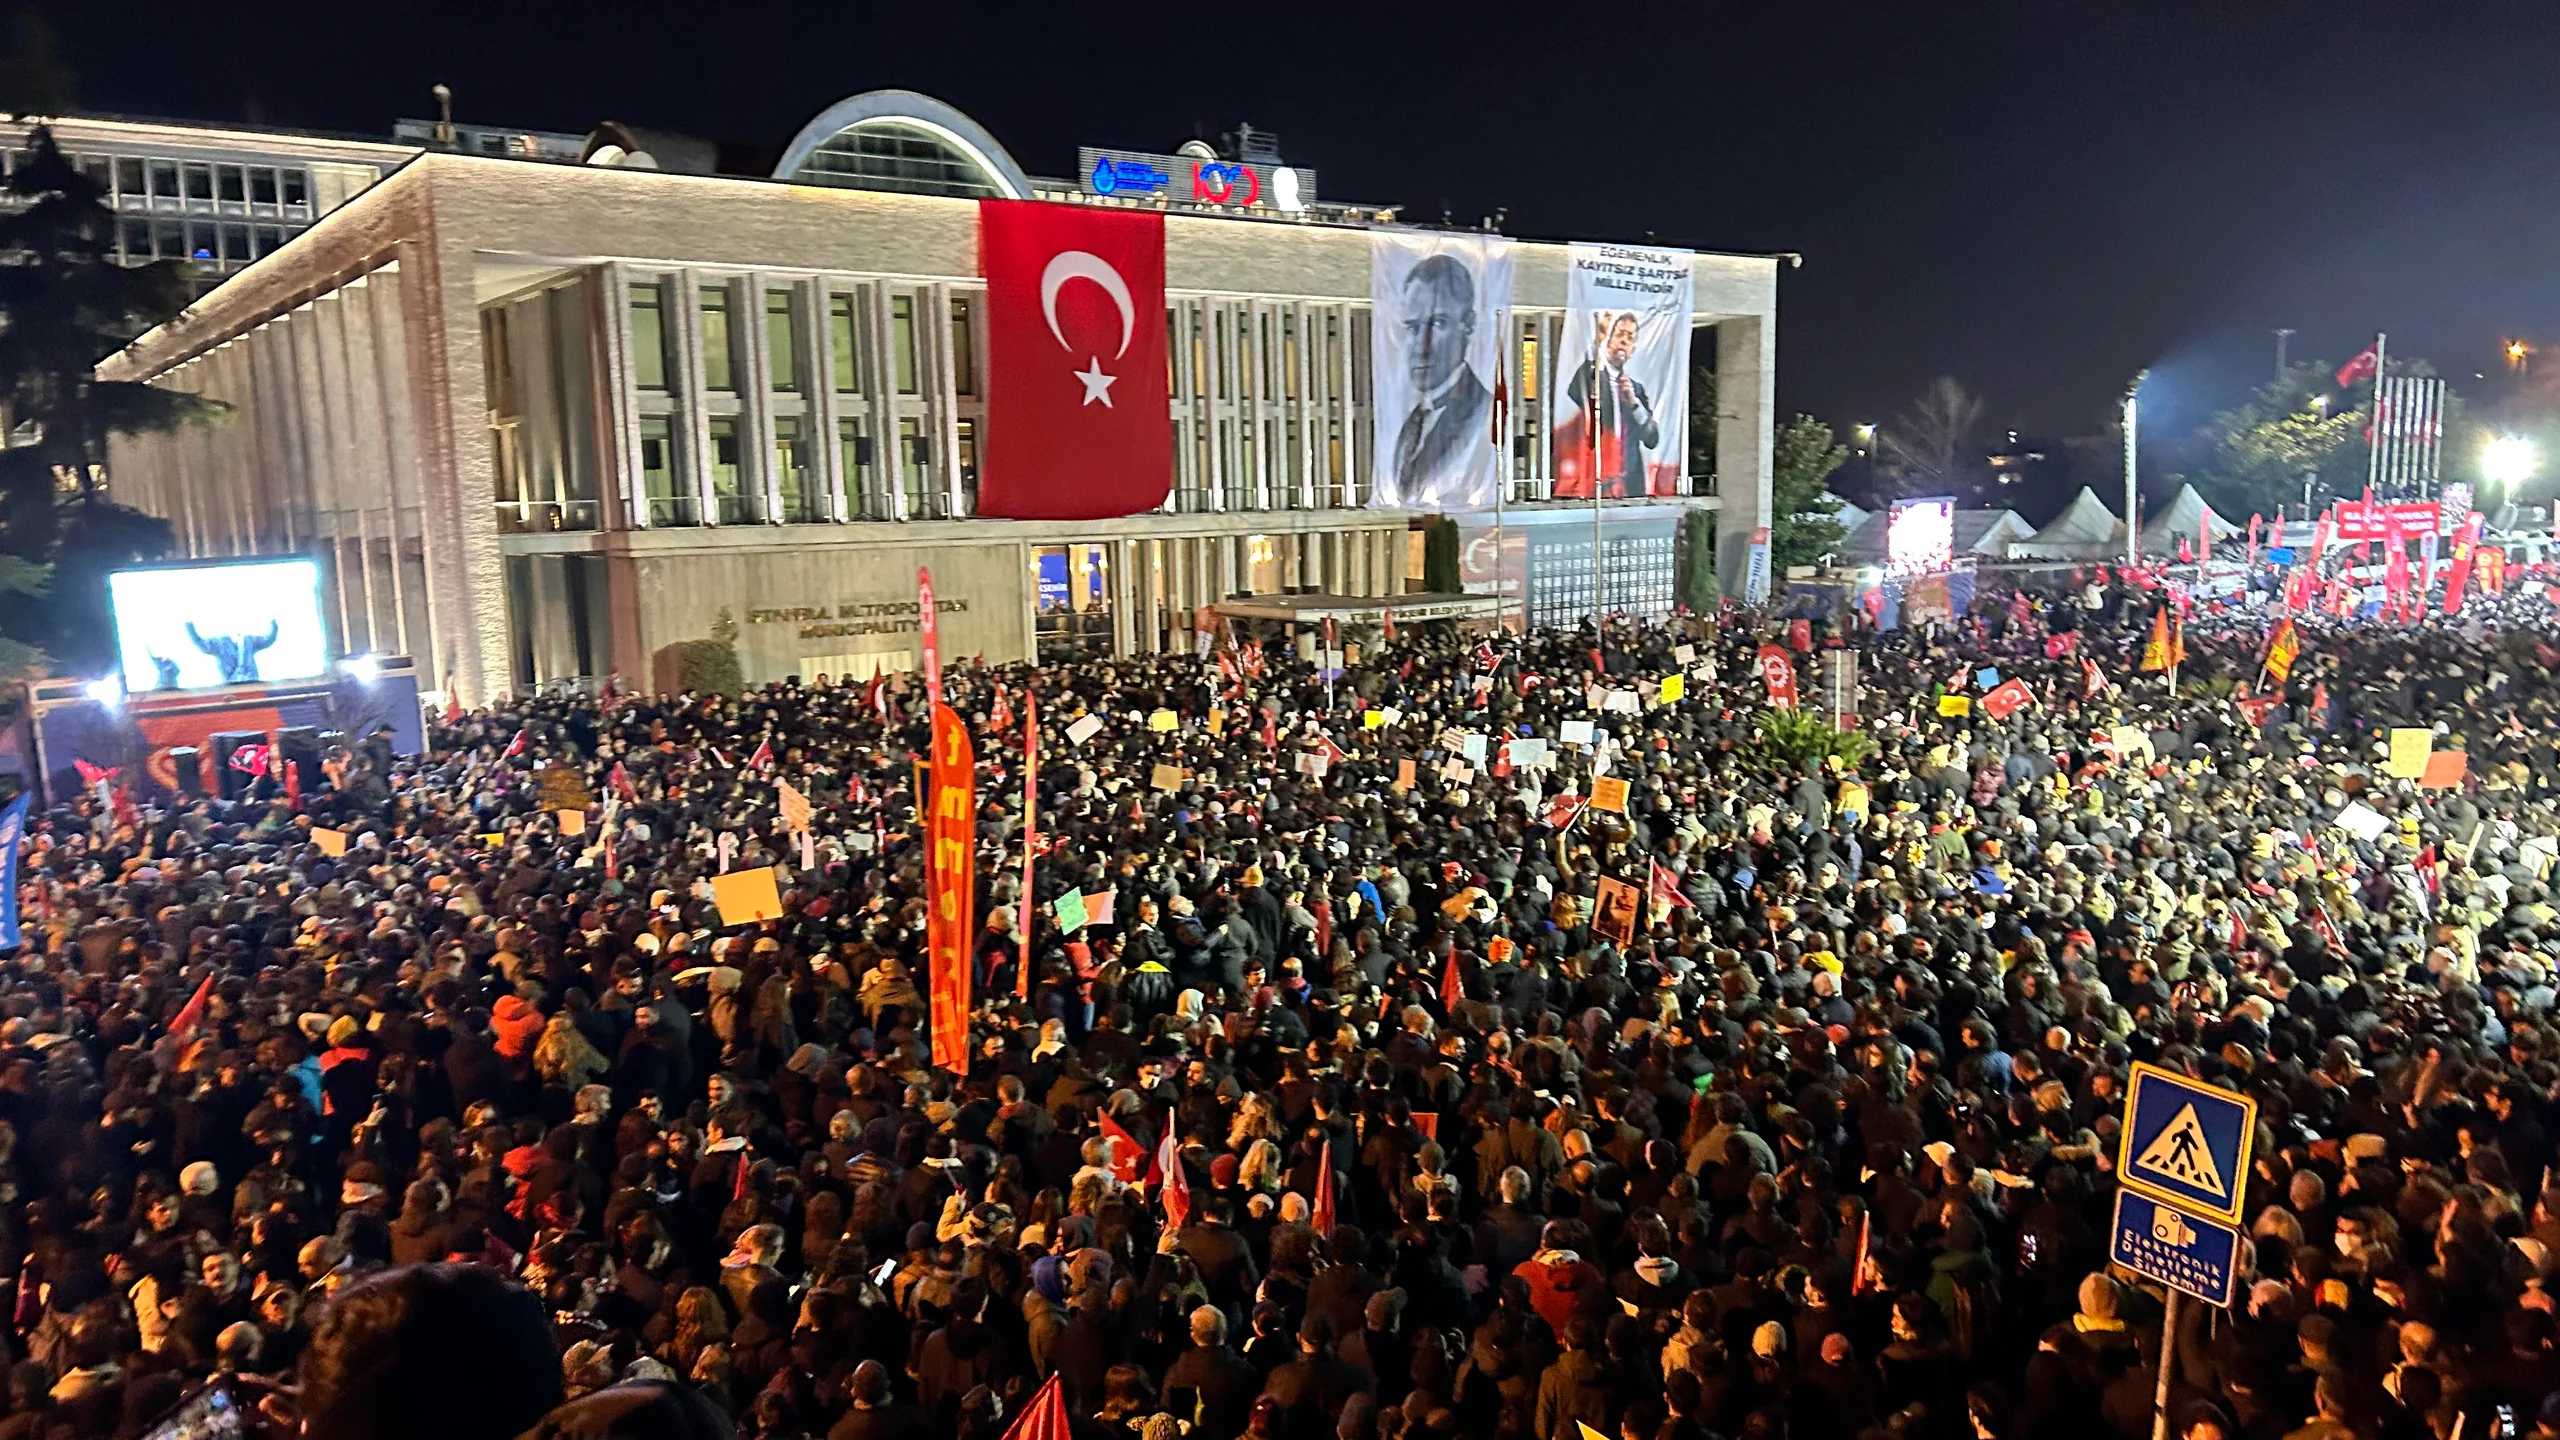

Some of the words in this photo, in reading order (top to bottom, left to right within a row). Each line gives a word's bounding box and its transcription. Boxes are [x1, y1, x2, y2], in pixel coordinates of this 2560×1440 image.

[1577, 259, 1636, 276] KAYITSIZ
[838, 599, 968, 618] METROPOTAN
[2122, 1240, 2220, 1290] Denetleme
[2124, 1228, 2221, 1278] Elektronik
[2133, 1256, 2204, 1295] Sistemi
